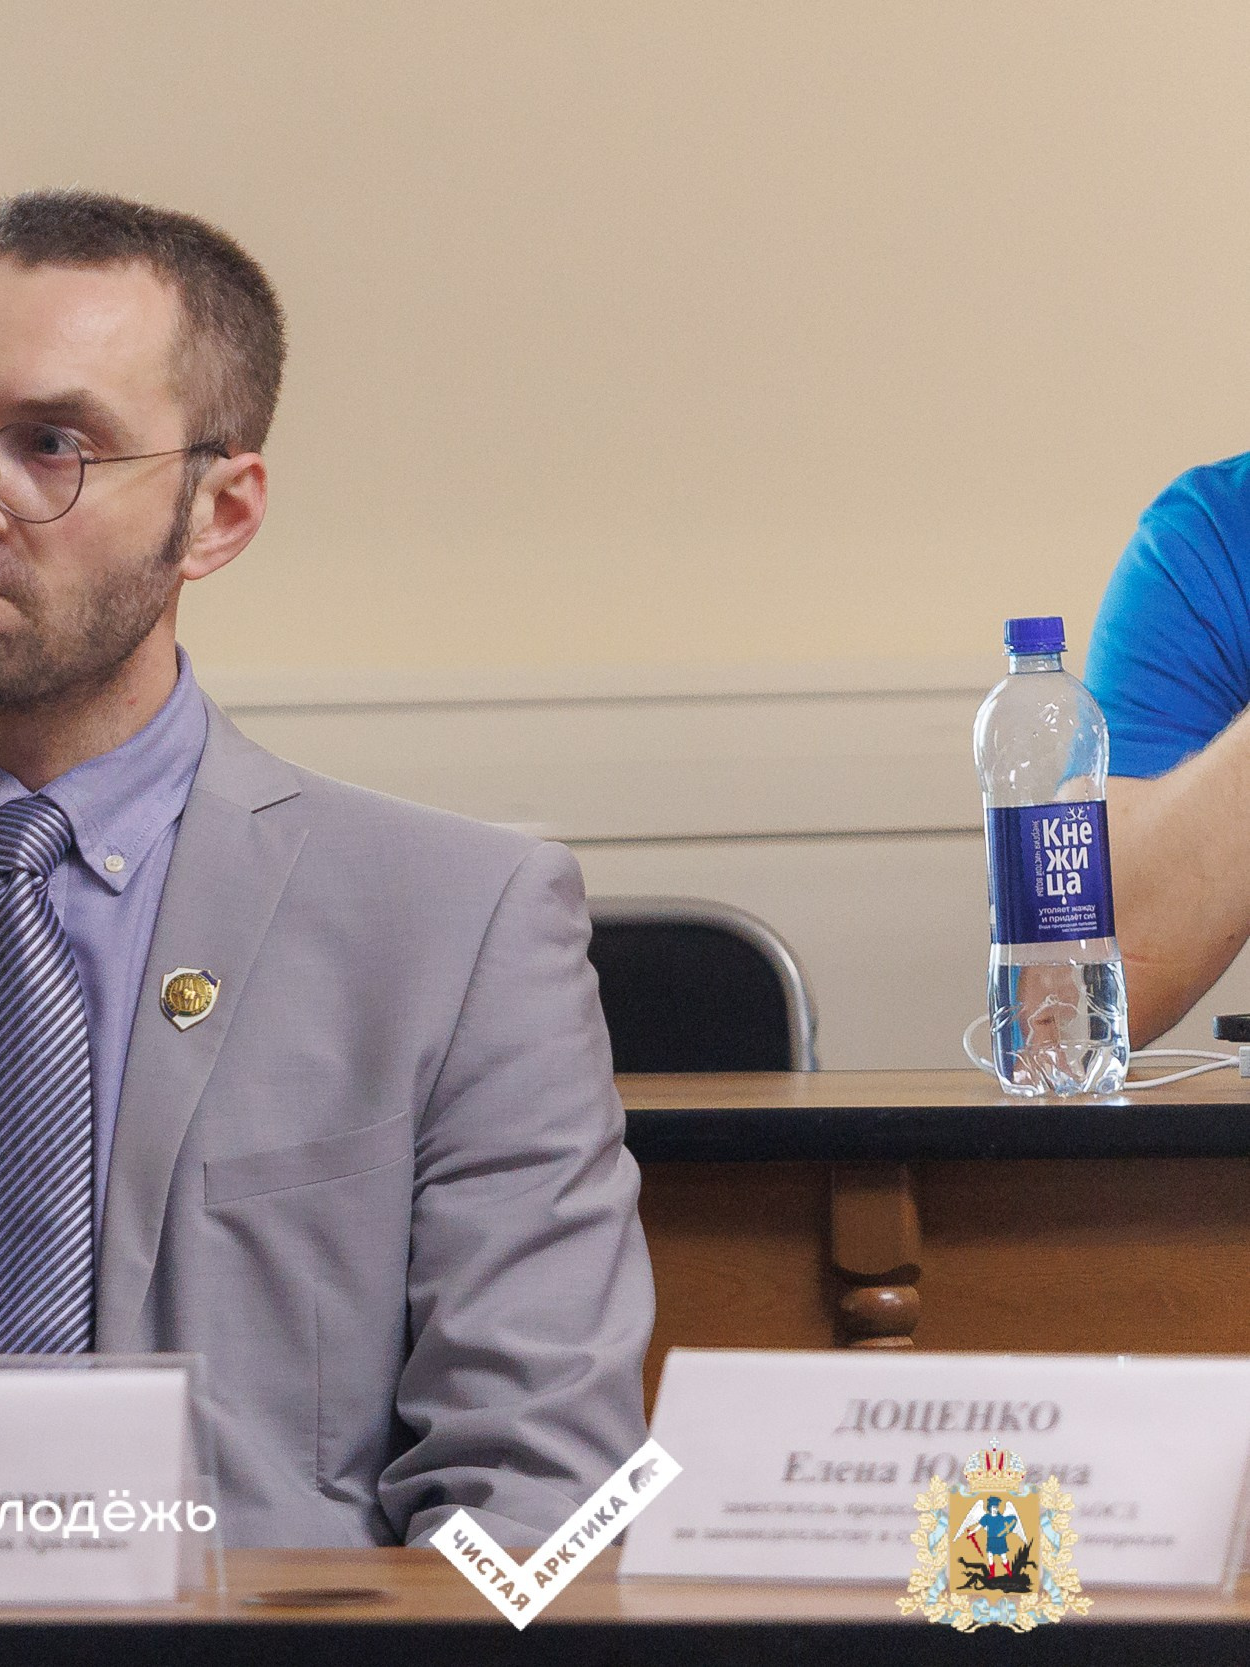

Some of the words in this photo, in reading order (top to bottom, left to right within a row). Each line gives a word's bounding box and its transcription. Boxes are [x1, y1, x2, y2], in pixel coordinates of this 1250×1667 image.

[1043, 818, 1093, 847] Кне
[1046, 847, 1089, 871] жи
[1046, 872, 1082, 896] ца
[1039, 906, 1070, 916] утоляет
[1071, 904, 1096, 912] жажду
[1083, 912, 1096, 920] сил
[834, 1398, 1063, 1435] ДОЦЕНКО
[782, 1450, 899, 1486] Елена
